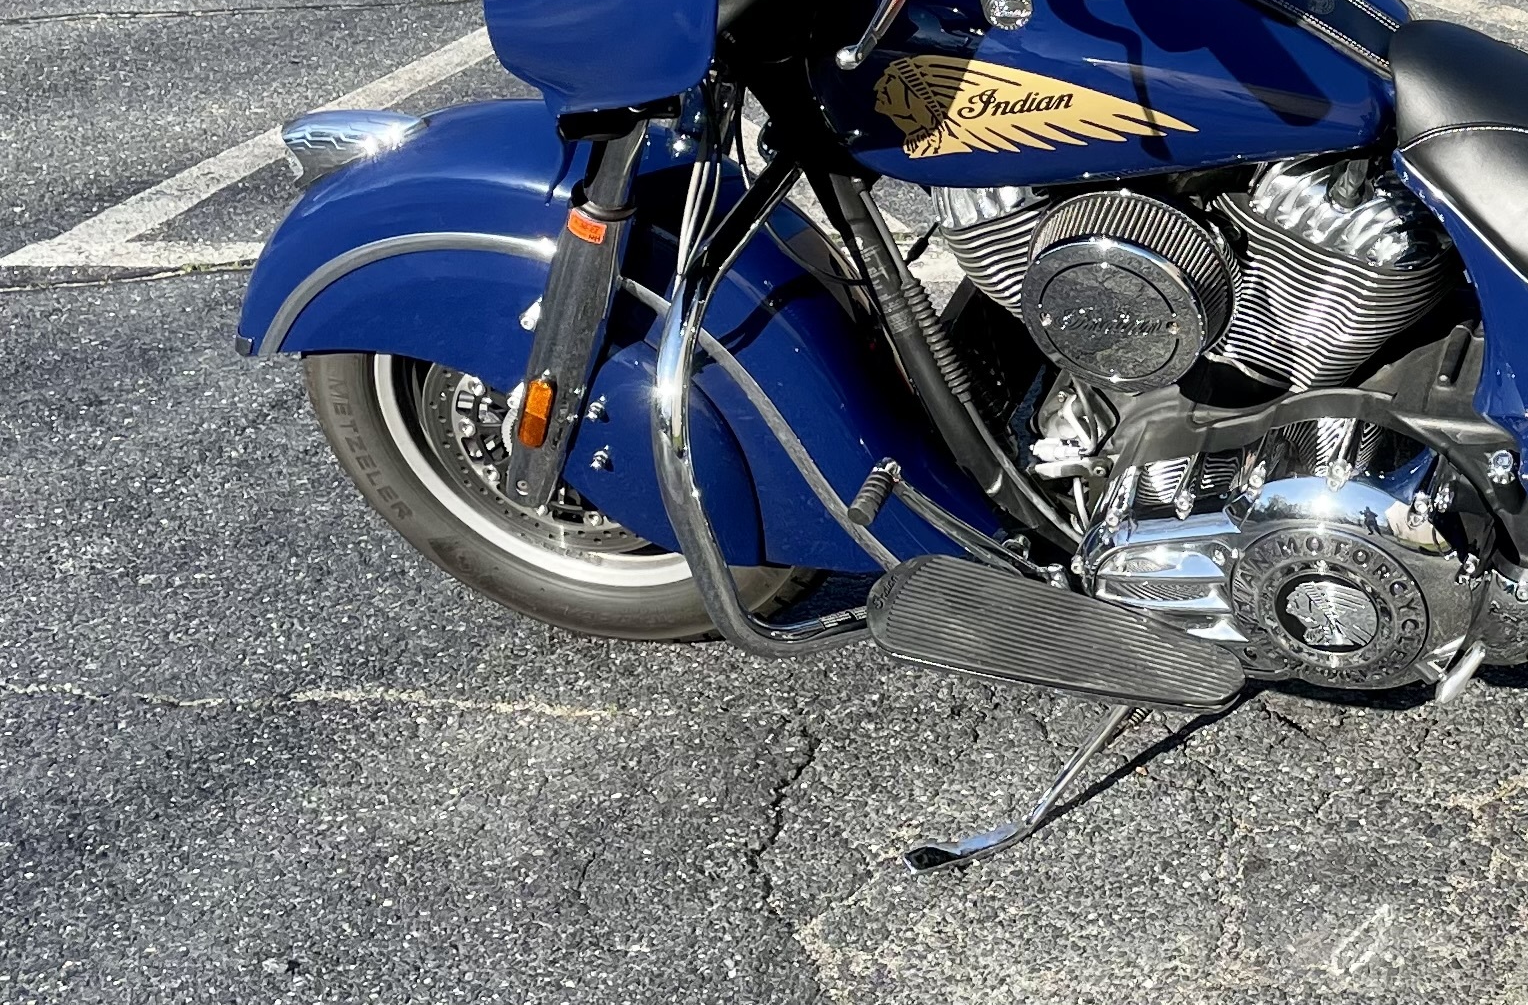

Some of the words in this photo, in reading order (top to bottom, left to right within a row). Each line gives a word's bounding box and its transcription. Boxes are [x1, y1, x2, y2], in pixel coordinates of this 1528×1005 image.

[958, 88, 1074, 120] Indian
[328, 376, 413, 520] METZELER
[1277, 536, 1421, 661] MOTORCYCLE
